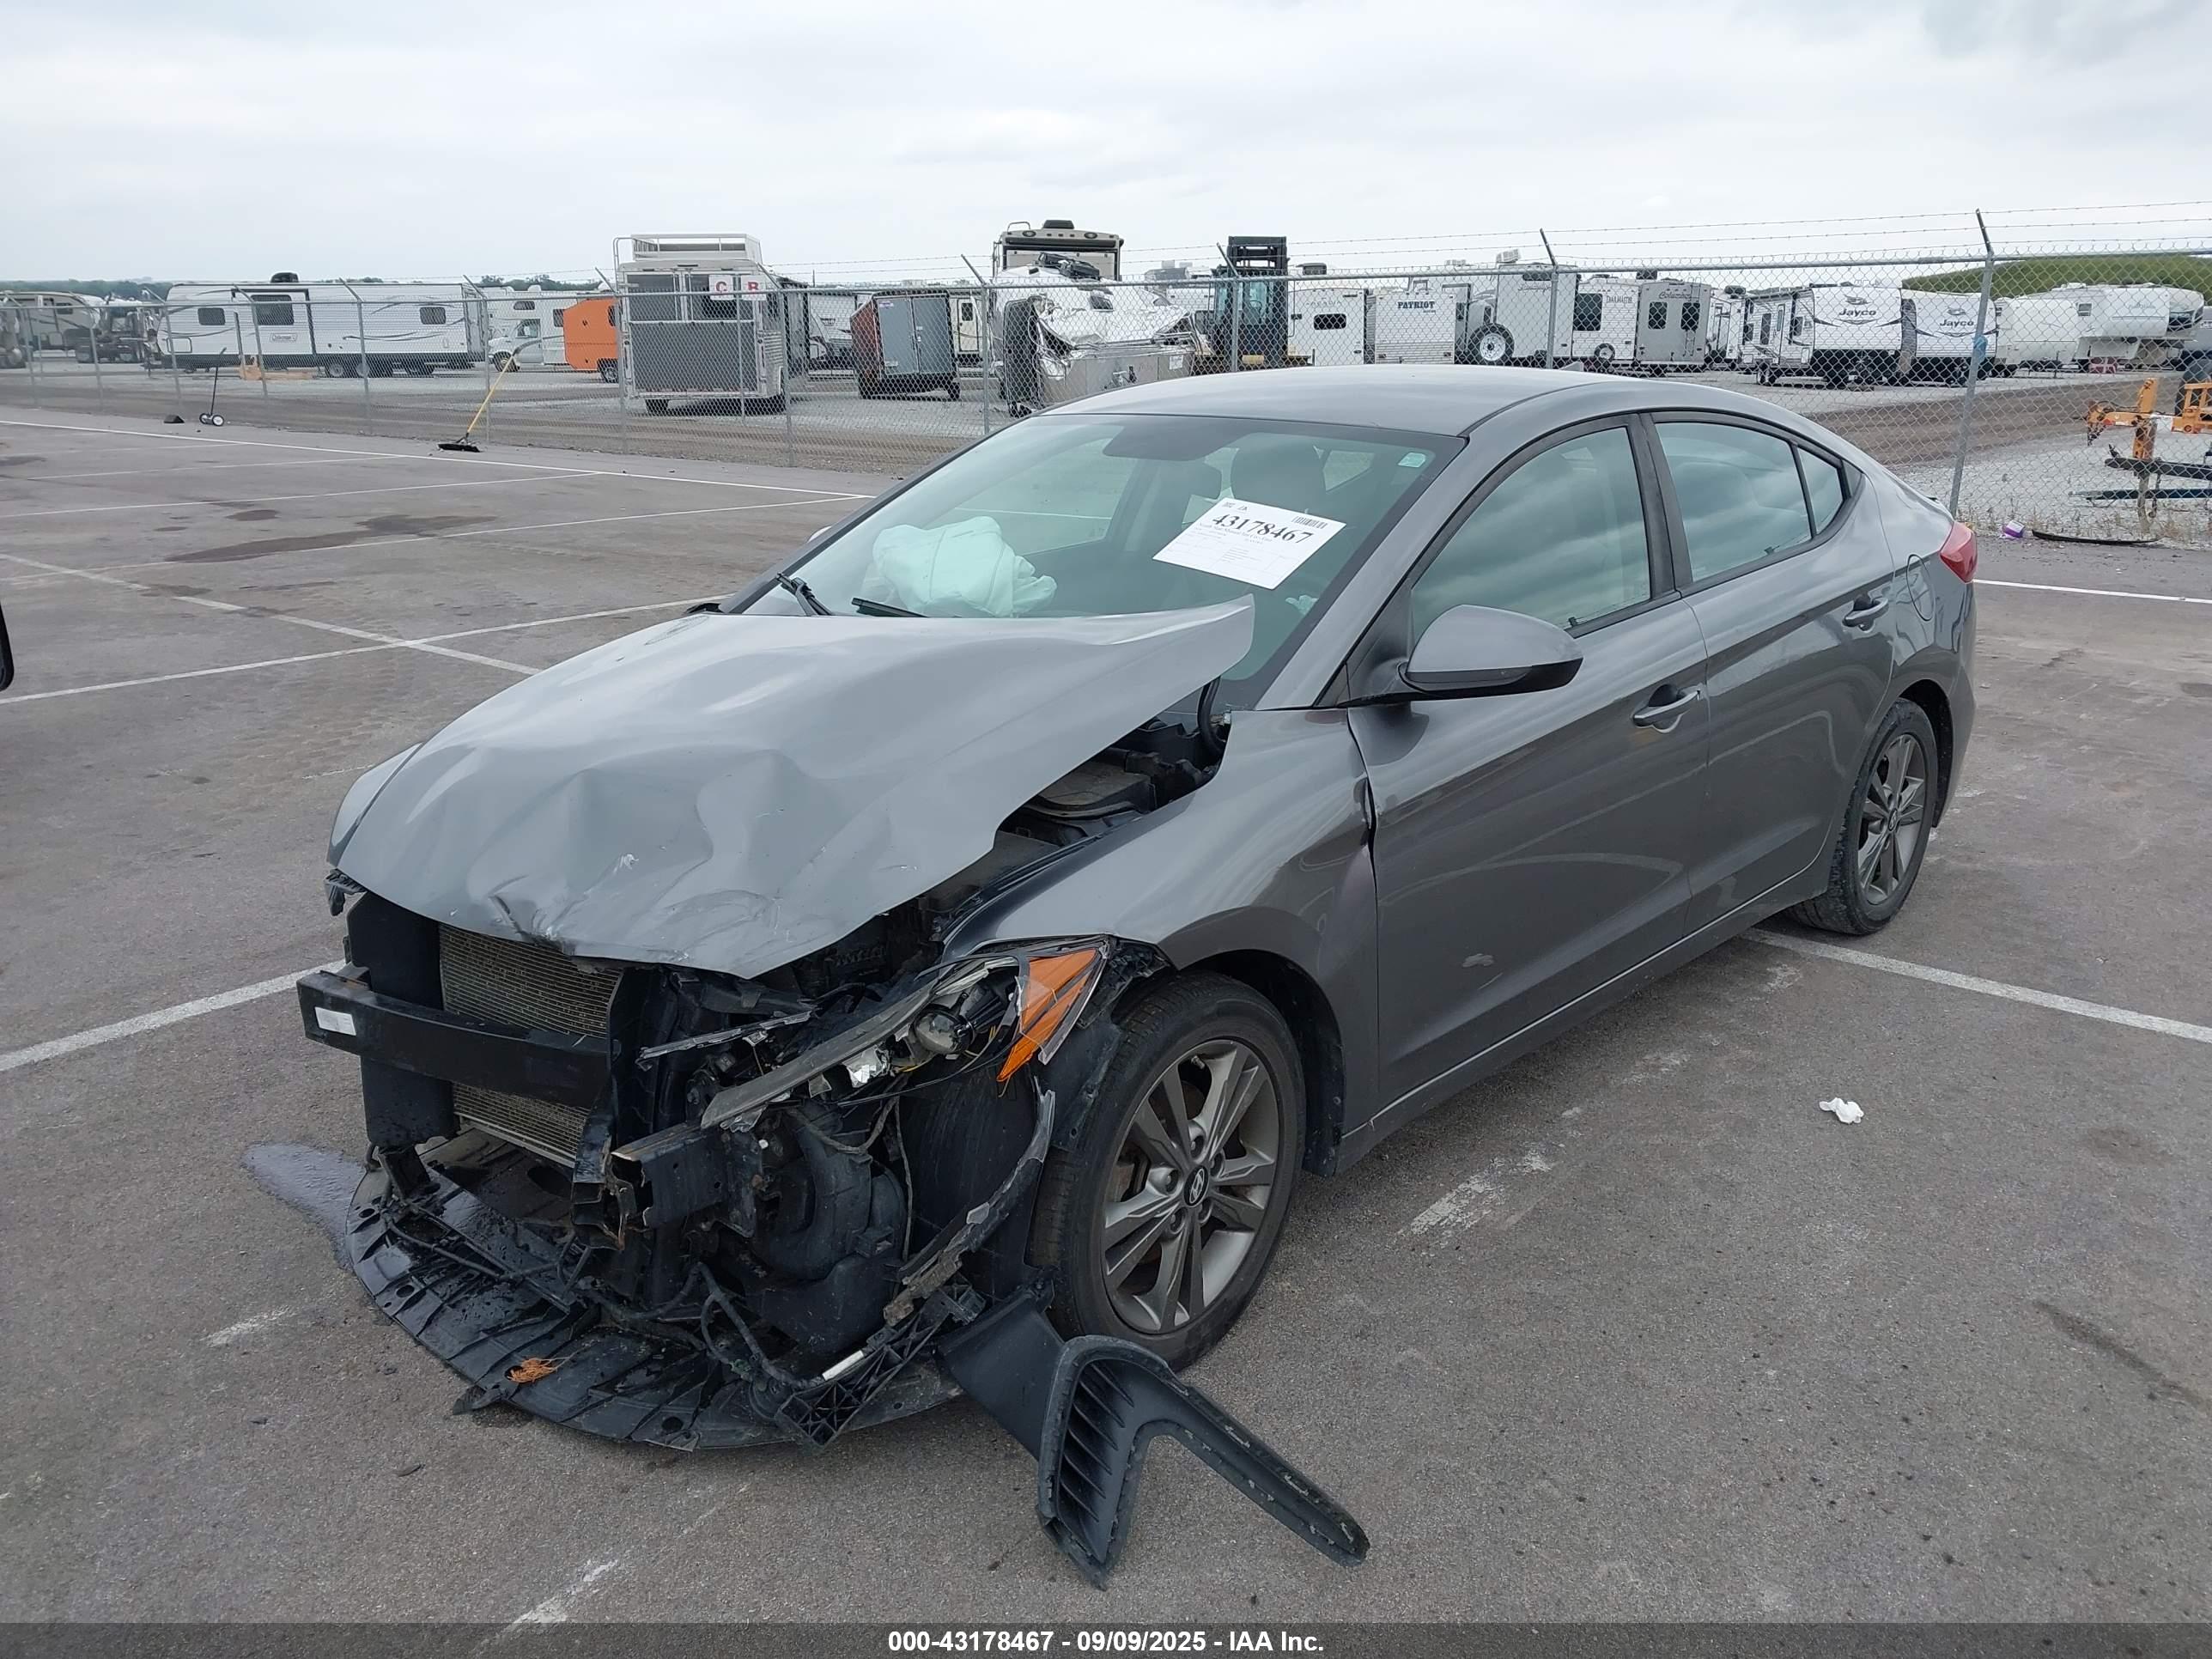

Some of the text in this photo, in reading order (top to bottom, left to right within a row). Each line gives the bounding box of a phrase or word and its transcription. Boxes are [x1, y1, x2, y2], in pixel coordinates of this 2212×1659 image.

[1397, 301, 1435, 309] PATRIOT
[1838, 308, 1877, 317] Jayco
[1939, 319, 1974, 327] Jayco
[1212, 514, 1315, 544] 43178467
